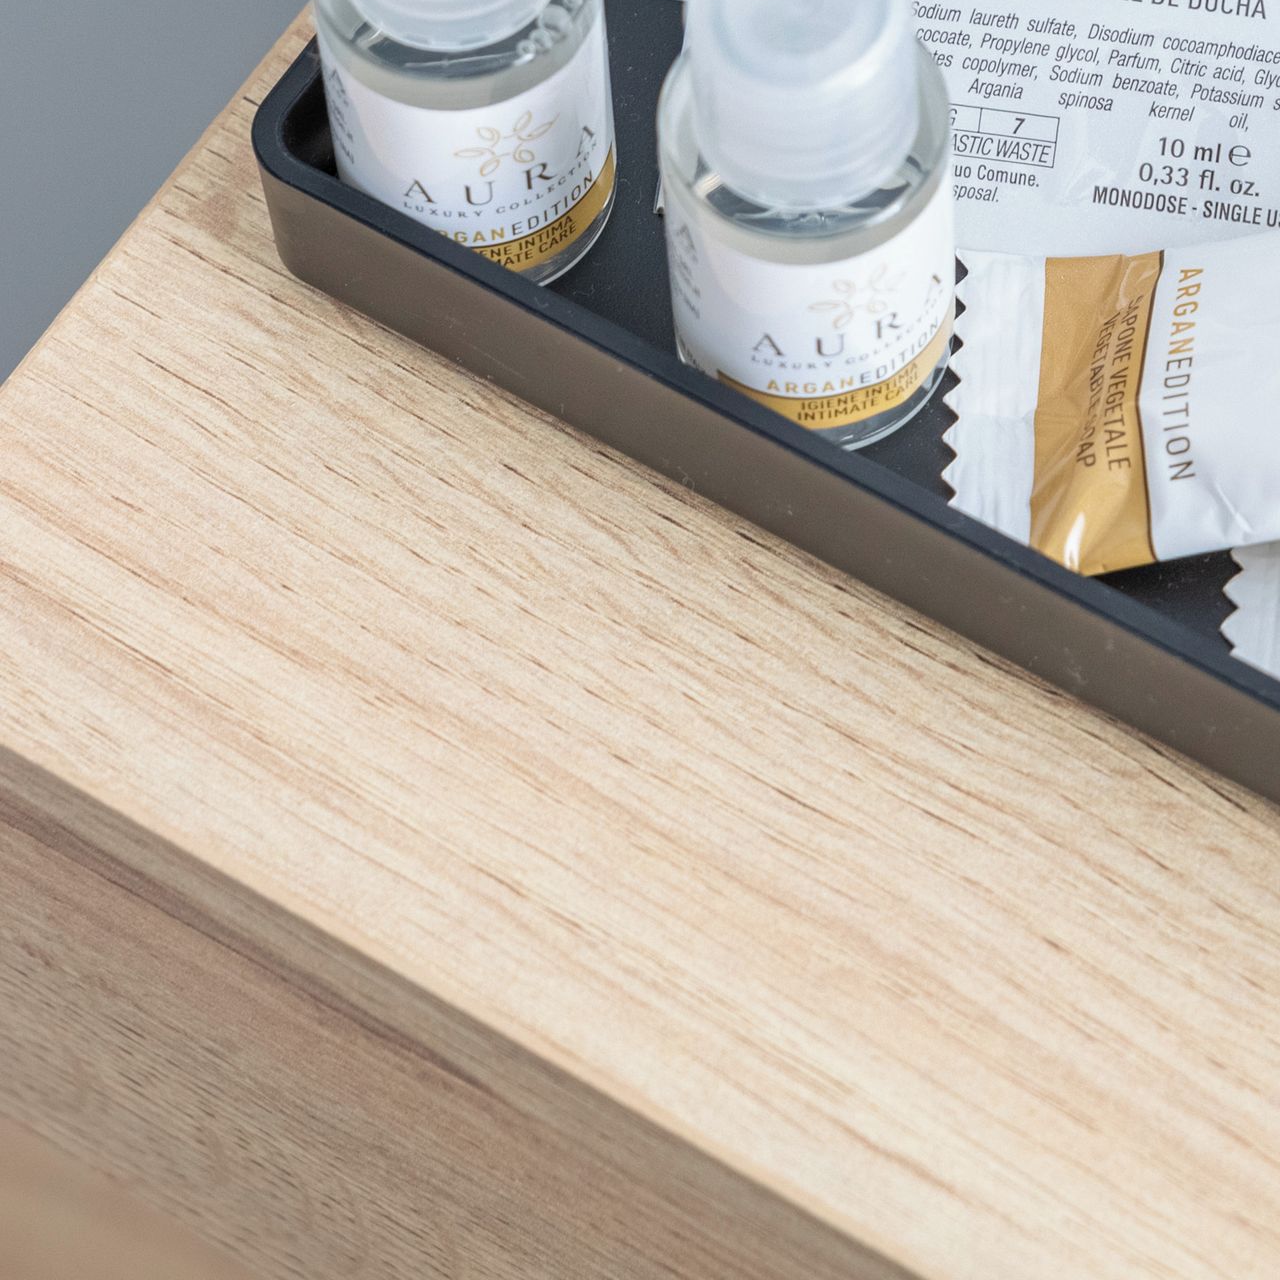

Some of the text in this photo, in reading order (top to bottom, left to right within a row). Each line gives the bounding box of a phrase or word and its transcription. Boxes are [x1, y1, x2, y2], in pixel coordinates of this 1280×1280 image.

[912, 0, 962, 23] Sodium
[969, 8, 1020, 30] laureth
[1026, 17, 1078, 39] sulfate,
[1087, 23, 1155, 47] Disodium
[916, 25, 972, 48] cocoate,
[980, 32, 1050, 58] Propylene
[1056, 42, 1101, 65] glycol,
[1107, 49, 1163, 73] Parfum,
[1170, 57, 1208, 77] Citric
[1212, 64, 1247, 85] acid,
[962, 56, 1039, 81] copolymer,
[1049, 64, 1103, 87] Sodium
[1112, 73, 1180, 100] benzoate,
[1190, 83, 1265, 108] Potassium
[967, 78, 1024, 101] Argania
[1058, 91, 1114, 112] spinosa
[1149, 101, 1196, 123] kernel
[1228, 113, 1249, 132] oil,
[1012, 117, 1026, 136] 7
[403, 125, 596, 207] AURA
[996, 139, 1053, 164] WASTE
[1159, 137, 1185, 158] 10
[1193, 142, 1222, 165] ml
[954, 163, 1041, 188] uo Comune.
[1138, 162, 1261, 198] 0,33 fl. oz.
[402, 201, 483, 218] LUXURY
[1092, 185, 1188, 216] MONODOSE
[1203, 200, 1263, 225] SINGLE
[518, 215, 574, 252] INTIMA
[538, 223, 578, 253] CARE
[1103, 293, 1144, 472] SAPONE VEGETALE
[797, 398, 880, 422] INTIMATE
[800, 394, 857, 412] IGIENE
